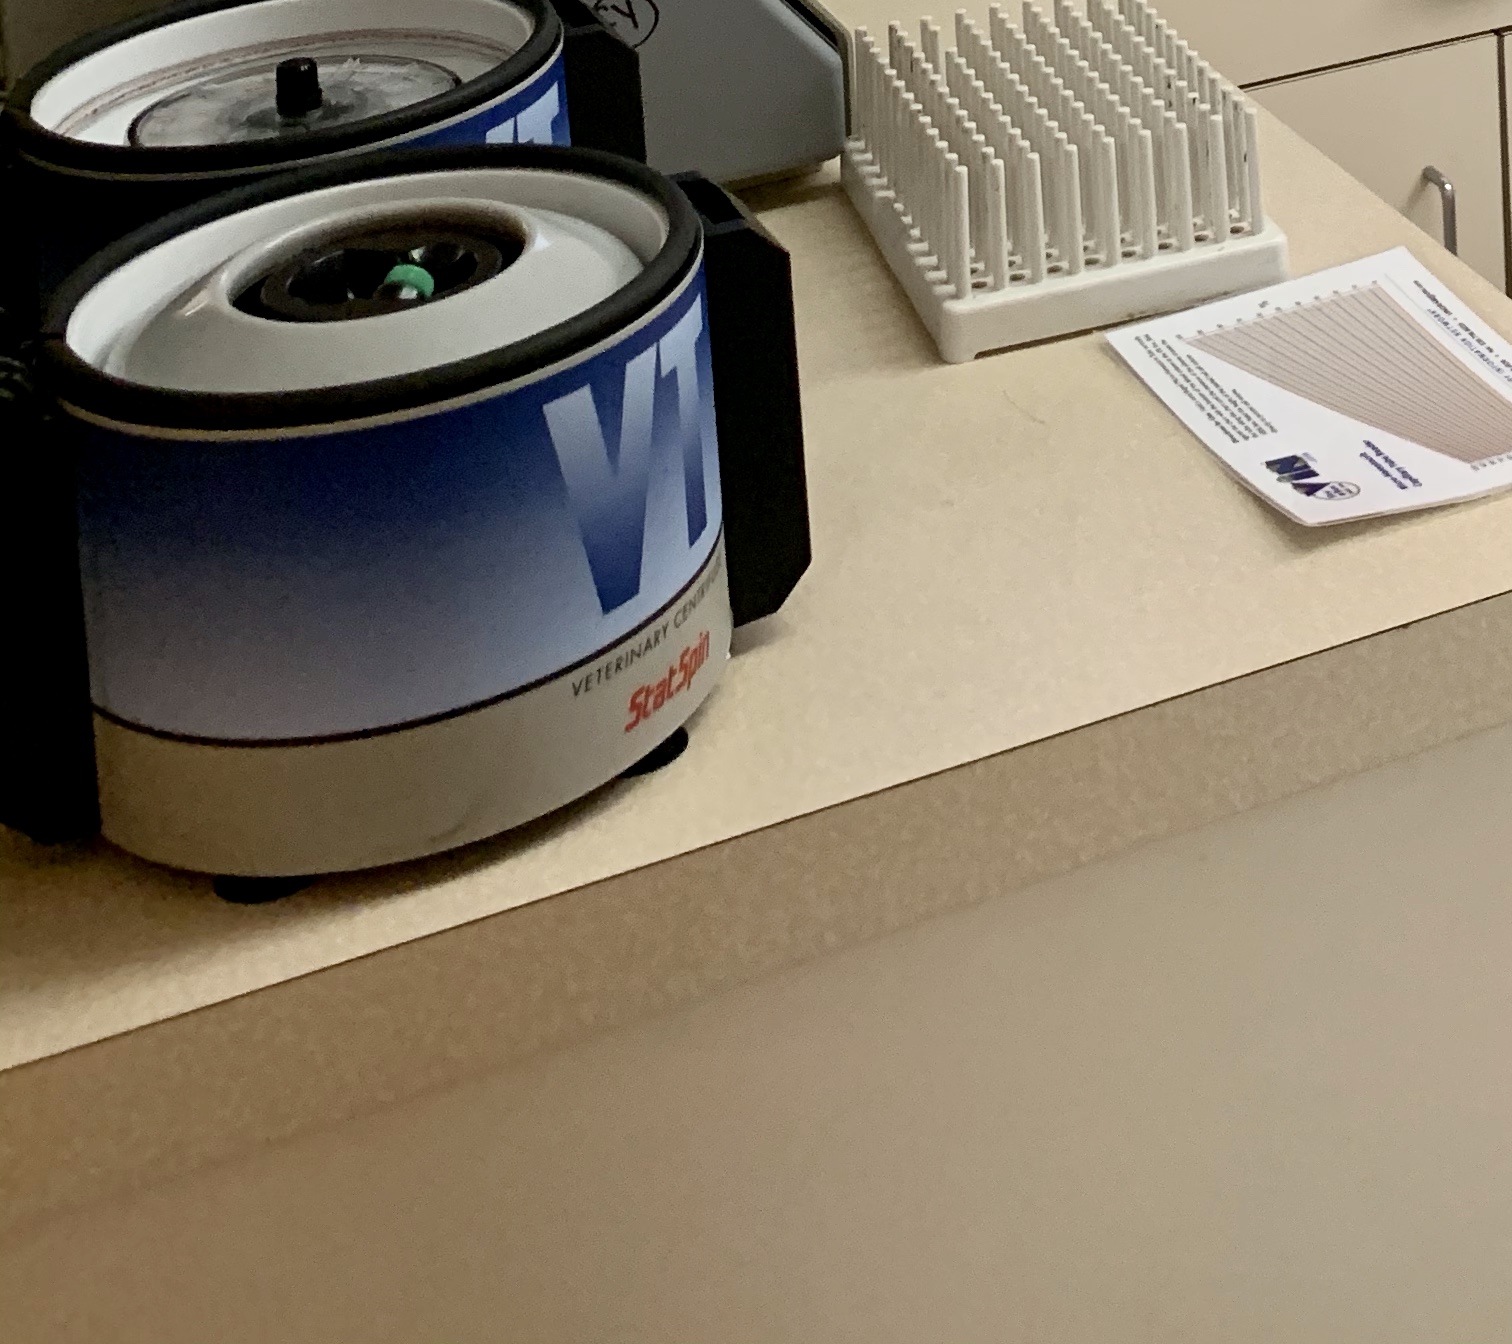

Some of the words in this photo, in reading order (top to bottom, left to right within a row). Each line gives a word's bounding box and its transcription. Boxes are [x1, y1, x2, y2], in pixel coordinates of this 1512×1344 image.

[542, 291, 708, 616] VT
[572, 621, 669, 697] VETERINARY
[624, 630, 710, 733] StatSpin
